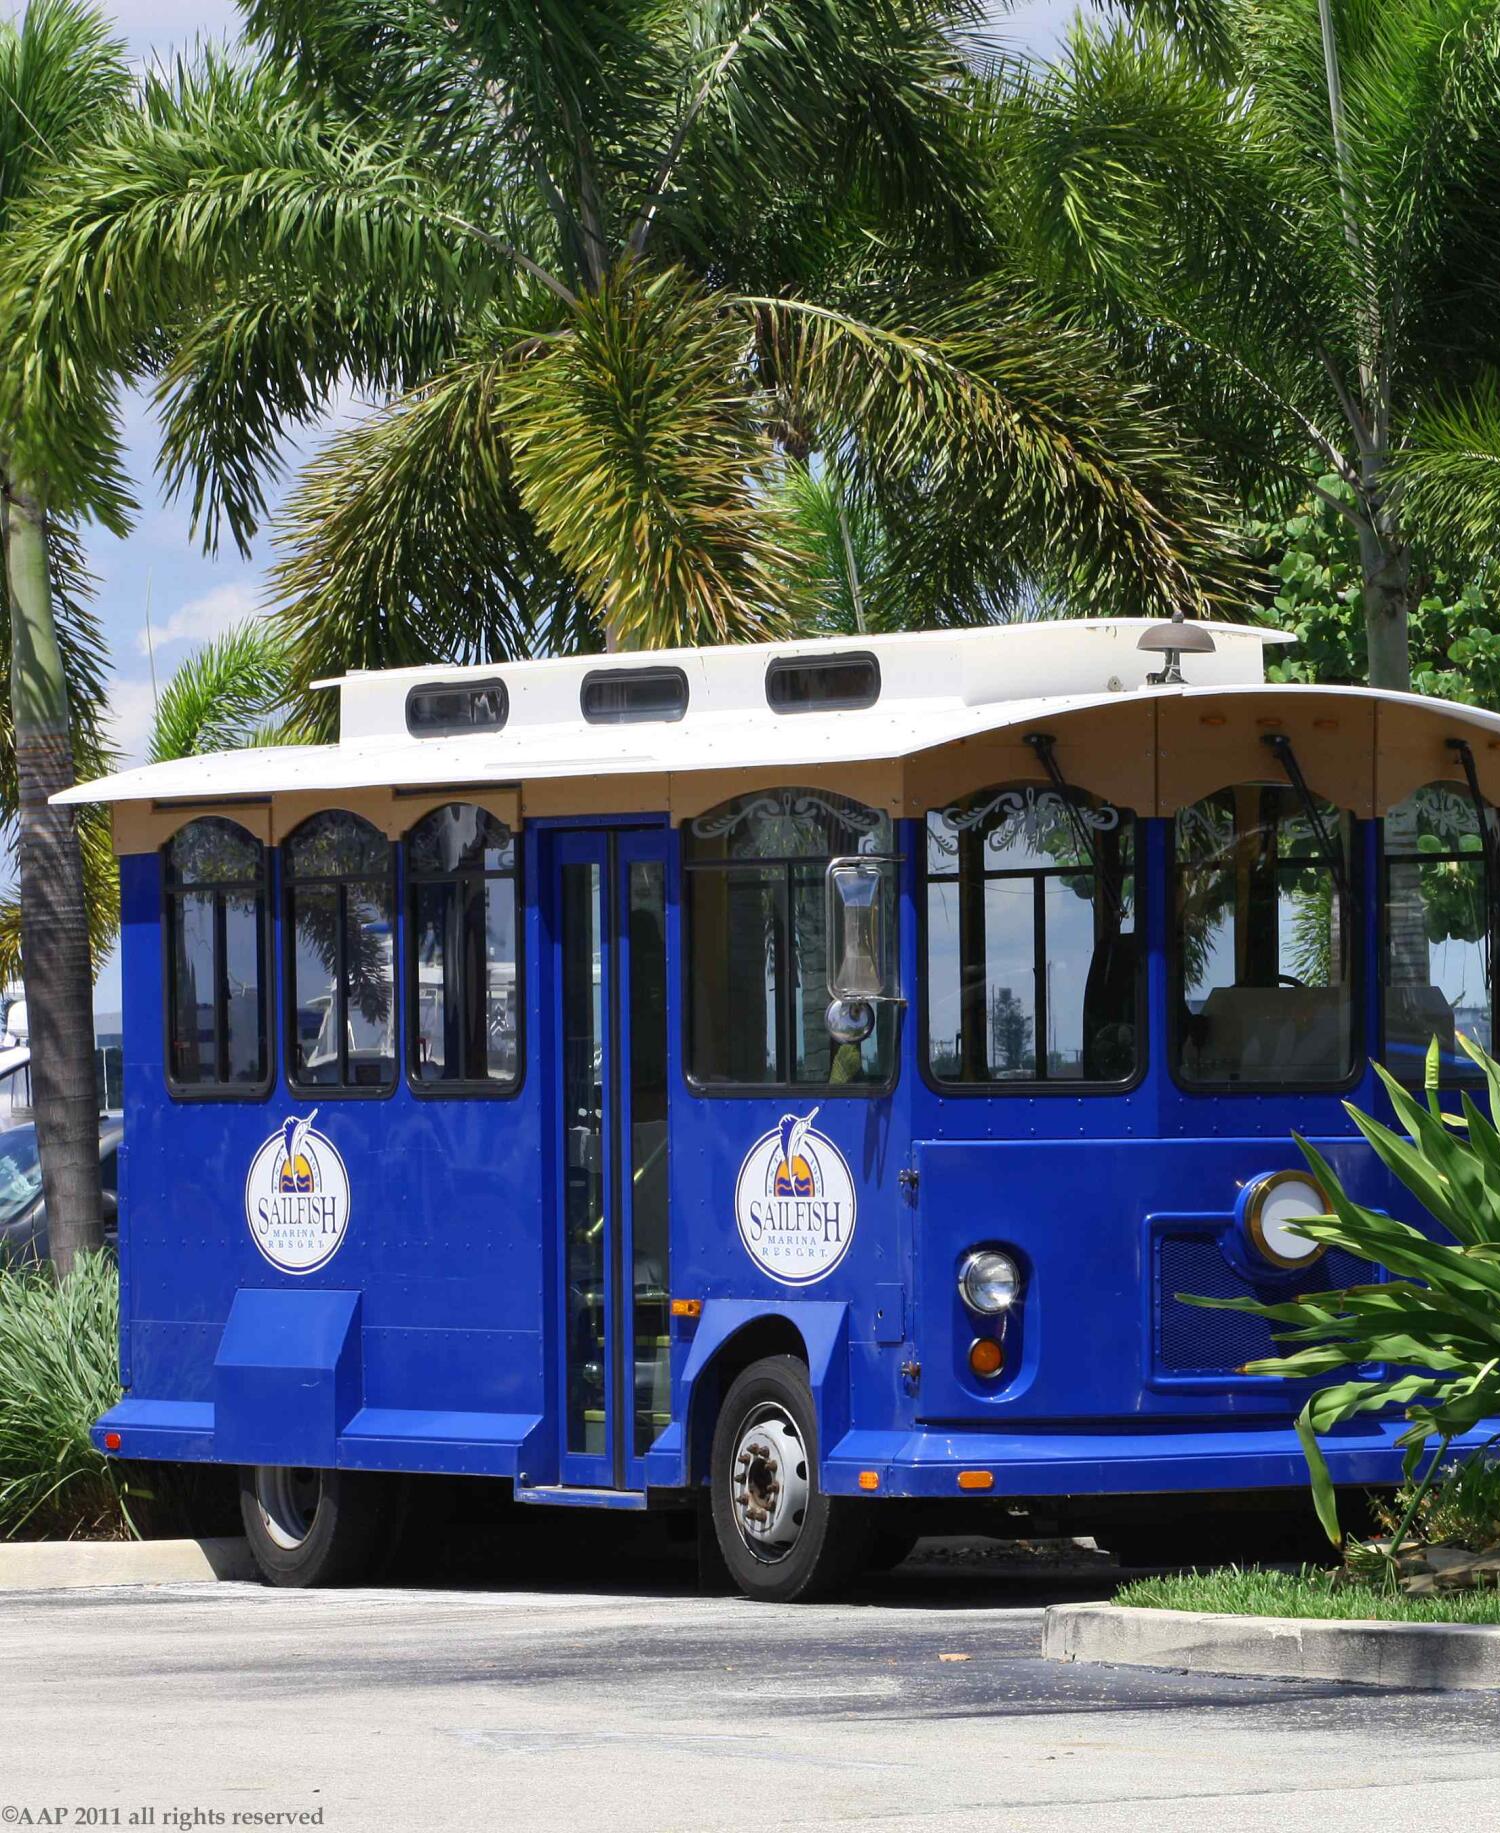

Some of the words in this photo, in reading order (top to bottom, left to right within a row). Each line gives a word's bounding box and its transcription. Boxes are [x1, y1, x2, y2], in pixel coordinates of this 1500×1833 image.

[258, 1196, 337, 1235] SAILFISH
[750, 1200, 842, 1242] SAILFISH
[273, 1228, 316, 1238] MARINA
[767, 1235, 817, 1246] MARINA
